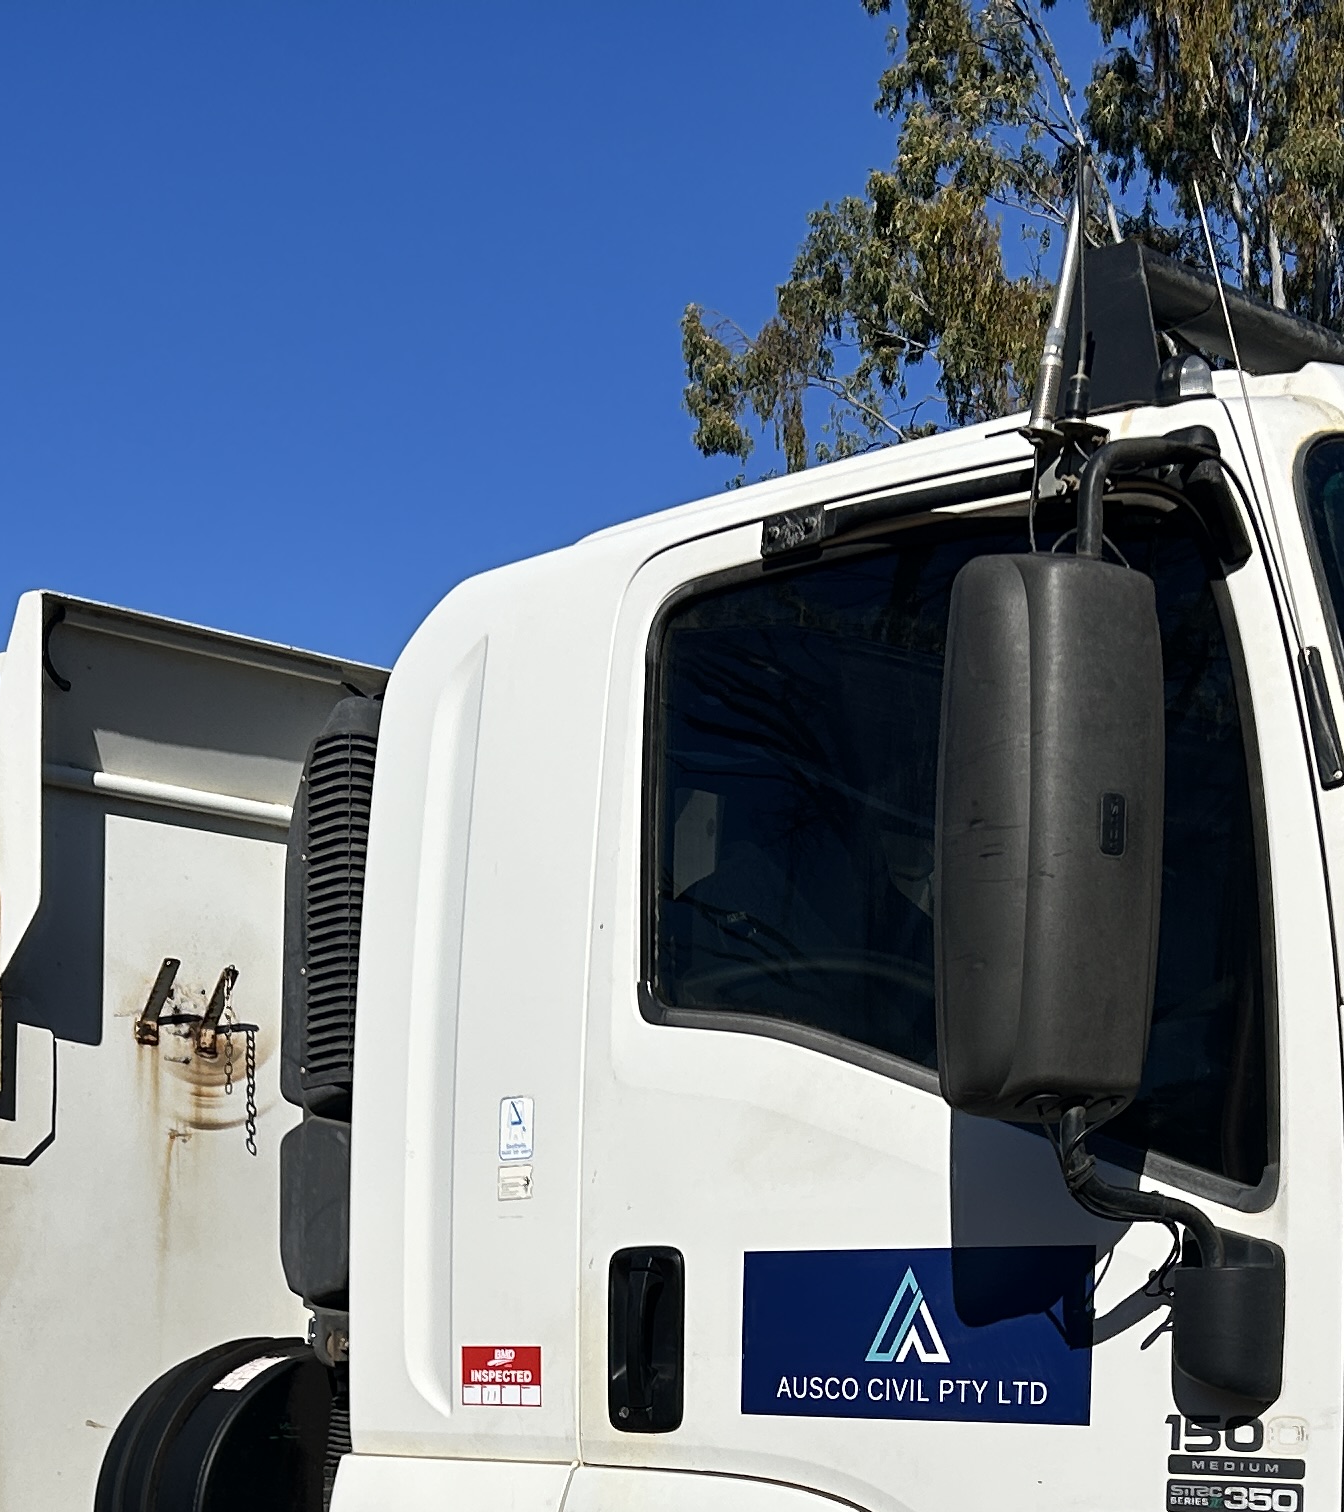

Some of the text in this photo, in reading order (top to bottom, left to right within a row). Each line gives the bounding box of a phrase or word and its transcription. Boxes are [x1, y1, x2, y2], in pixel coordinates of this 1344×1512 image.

[470, 1369, 532, 1383] INSPECTED
[776, 1376, 1047, 1405] AUSCO CIVIL PTY LTD
[1191, 1460, 1279, 1473] MEDIUM
[1170, 1496, 1209, 1506] SERIES
[1224, 1486, 1298, 1512] 350
